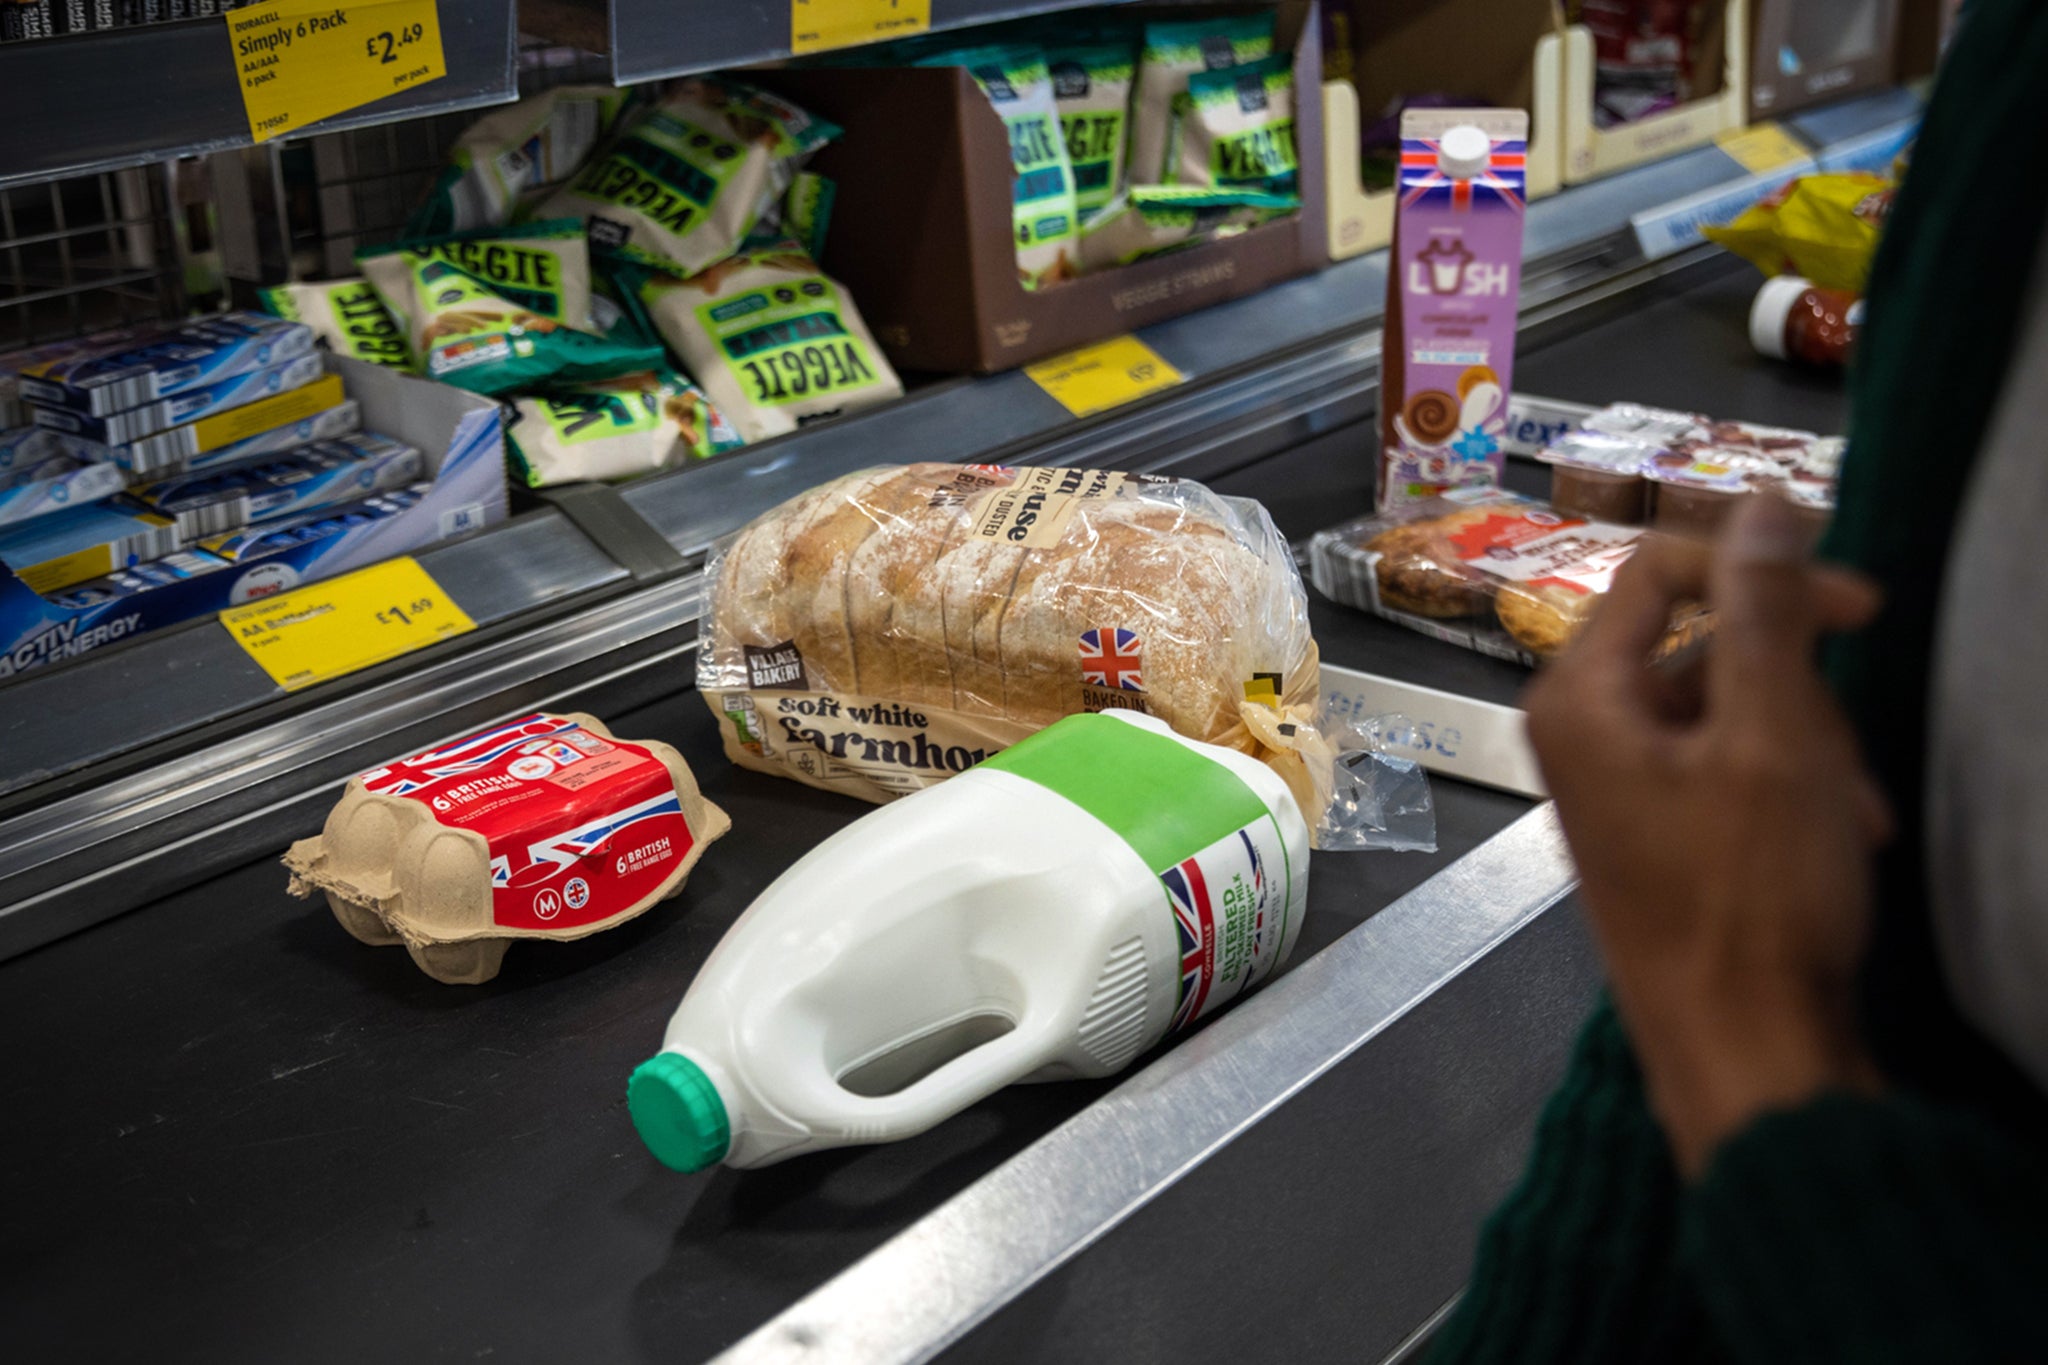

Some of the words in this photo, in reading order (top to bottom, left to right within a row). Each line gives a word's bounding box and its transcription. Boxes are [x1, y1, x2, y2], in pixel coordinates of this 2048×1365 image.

[235, 12, 280, 32] DURACELL
[239, 27, 293, 56] Simply
[296, 23, 306, 38] 6
[309, 9, 347, 34] Pack
[366, 23, 423, 64] £2.49
[243, 54, 280, 73] AA/AAA
[254, 69, 277, 88] pack
[392, 74, 408, 86] per
[410, 65, 430, 80] pack
[1407, 260, 1510, 297] LUSH
[742, 341, 873, 400] VEGGIE
[982, 501, 1014, 537] DUSTED
[48, 613, 142, 664] ENERGY
[752, 664, 801, 687] BAKERY
[847, 703, 929, 729] white
[1083, 688, 1128, 709] BAKED
[1131, 698, 1148, 714] IN
[778, 716, 999, 773] farmho
[432, 796, 451, 811] 6
[446, 774, 515, 799] BRITISH
[616, 856, 627, 874] 6
[628, 836, 671, 863] BRITISH
[630, 863, 643, 873] FREE
[643, 855, 660, 867] RANGE
[539, 894, 557, 915] M
[1232, 872, 1245, 902] MILK
[1204, 923, 1212, 980] COWBELLE
[1221, 888, 1239, 983] FILTERED
